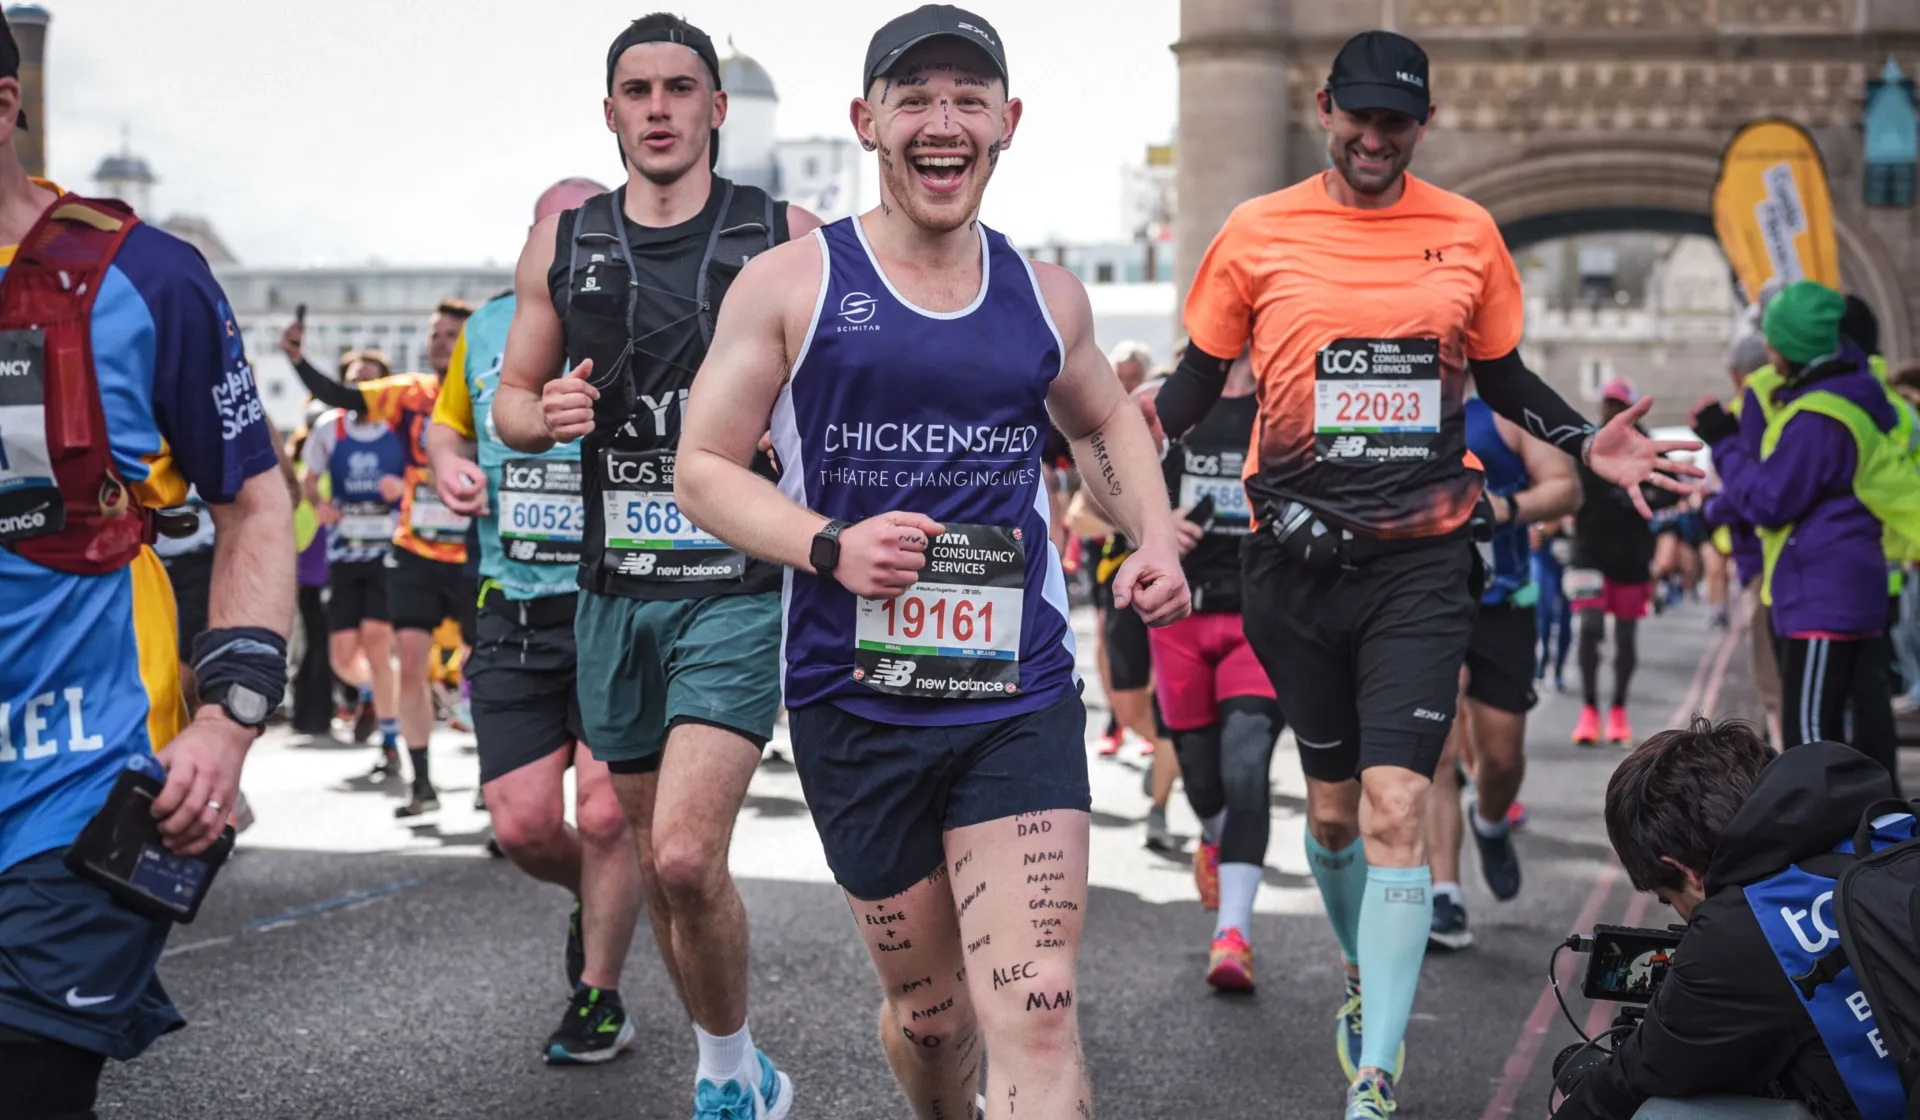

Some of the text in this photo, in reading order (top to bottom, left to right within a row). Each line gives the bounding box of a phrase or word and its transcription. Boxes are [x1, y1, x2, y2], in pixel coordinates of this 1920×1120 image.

[836, 325, 881, 333] SCIMITAR
[1373, 343, 1401, 354] TATA
[1322, 349, 1369, 374] tcs
[1372, 354, 1434, 364] CONSULTANCY
[1372, 365, 1412, 374] SERVICES
[1336, 392, 1421, 422] 22023
[824, 421, 1038, 453] CHICKENSHED
[1090, 432, 1115, 485] GABRIEL
[1366, 448, 1388, 457] new
[1390, 446, 1430, 459] balance
[505, 462, 543, 489] tcs
[606, 453, 658, 484] tcs
[820, 467, 1035, 488] THEATRE CHANGING LIVES
[512, 502, 584, 530] 60523
[935, 532, 970, 546] TATA
[932, 546, 1016, 563] CONSULTANCY
[656, 566, 681, 576] new
[682, 564, 732, 576] balance
[931, 560, 986, 576] SERVICES
[881, 595, 993, 643] 19161
[916, 678, 947, 691] new
[949, 677, 1004, 693] balance
[1017, 820, 1052, 837] DAD
[1023, 850, 1064, 866] NANA
[1026, 872, 1066, 884] NANA
[1029, 899, 1079, 911] GRANDPA
[1031, 919, 1062, 929] TARA
[992, 961, 1039, 991] ALEC
